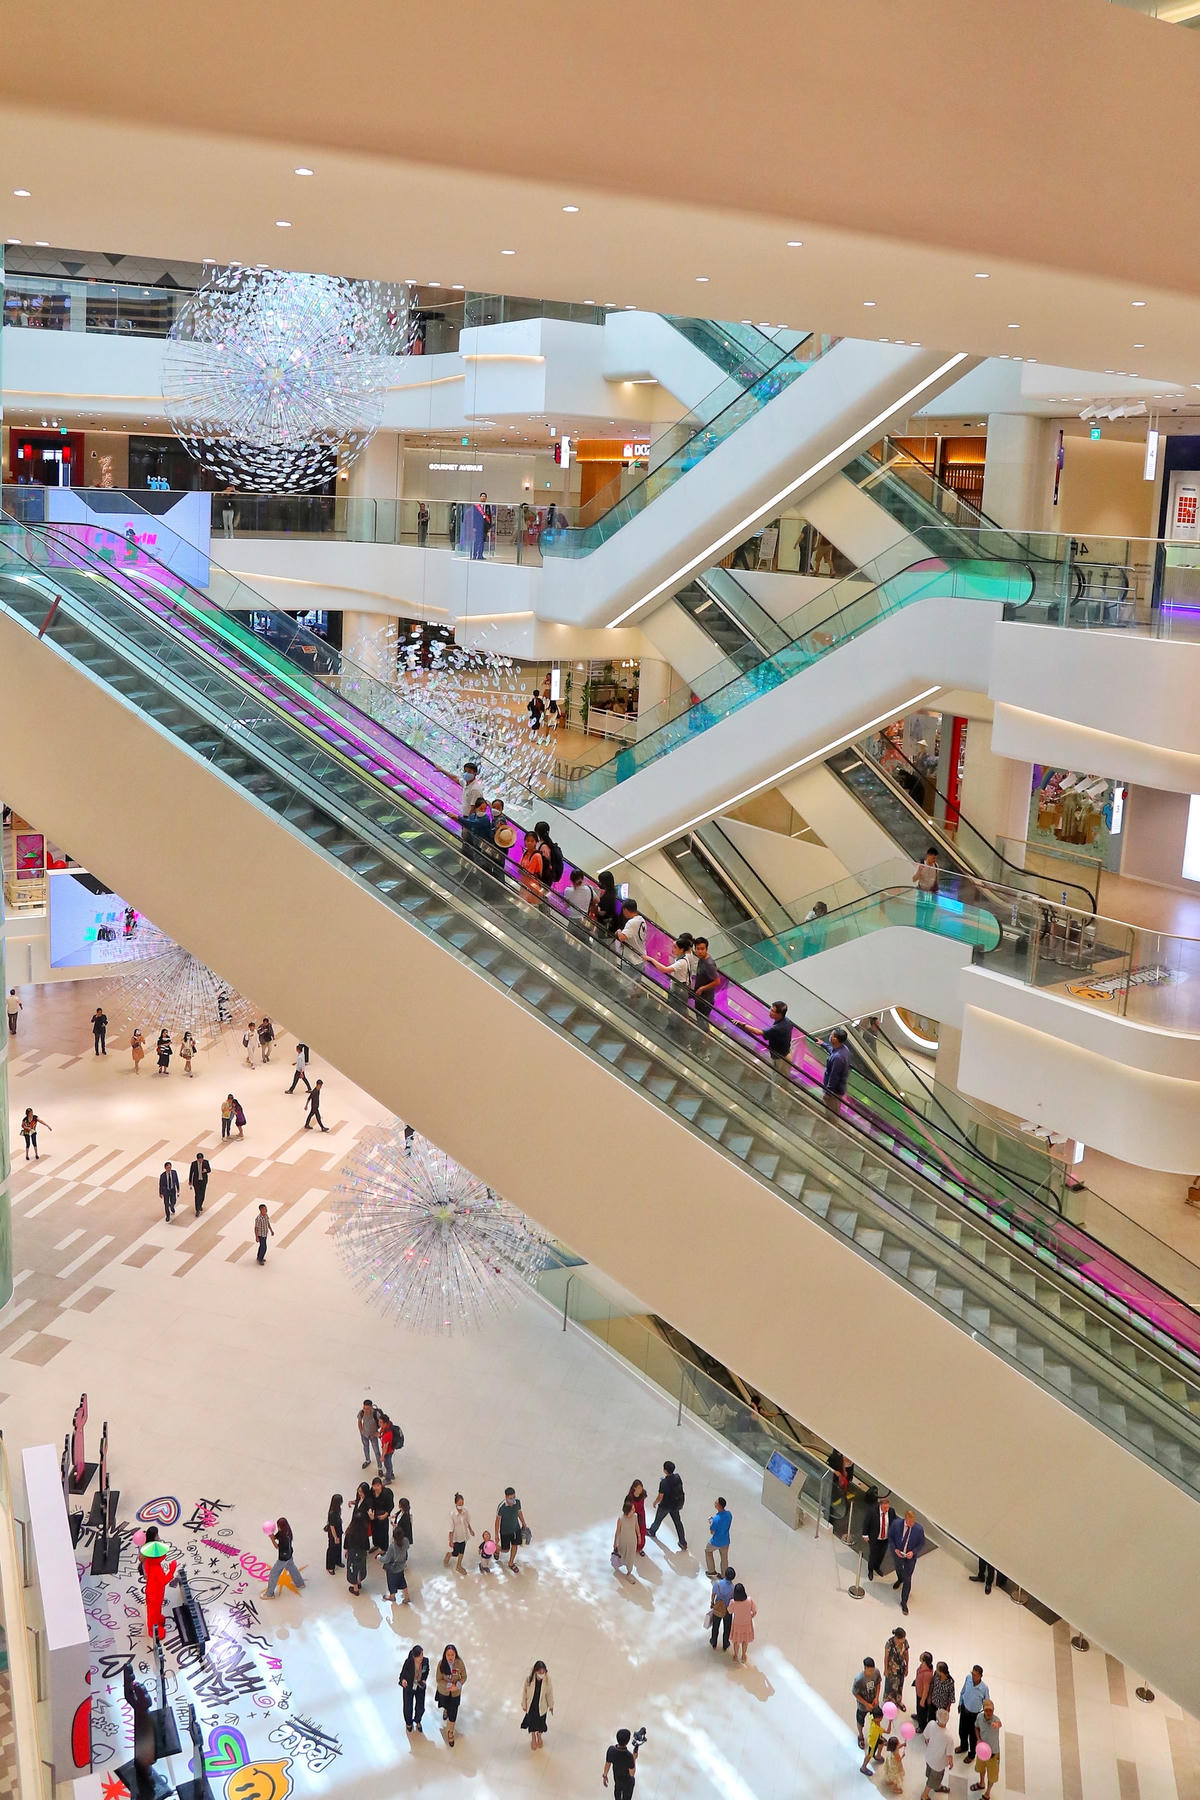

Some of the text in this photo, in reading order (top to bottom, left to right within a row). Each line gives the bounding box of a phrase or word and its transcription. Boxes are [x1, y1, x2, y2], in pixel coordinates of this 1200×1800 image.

[429, 463, 483, 472] GOURMET AVENUE
[268, 1723, 337, 1774] Peace
